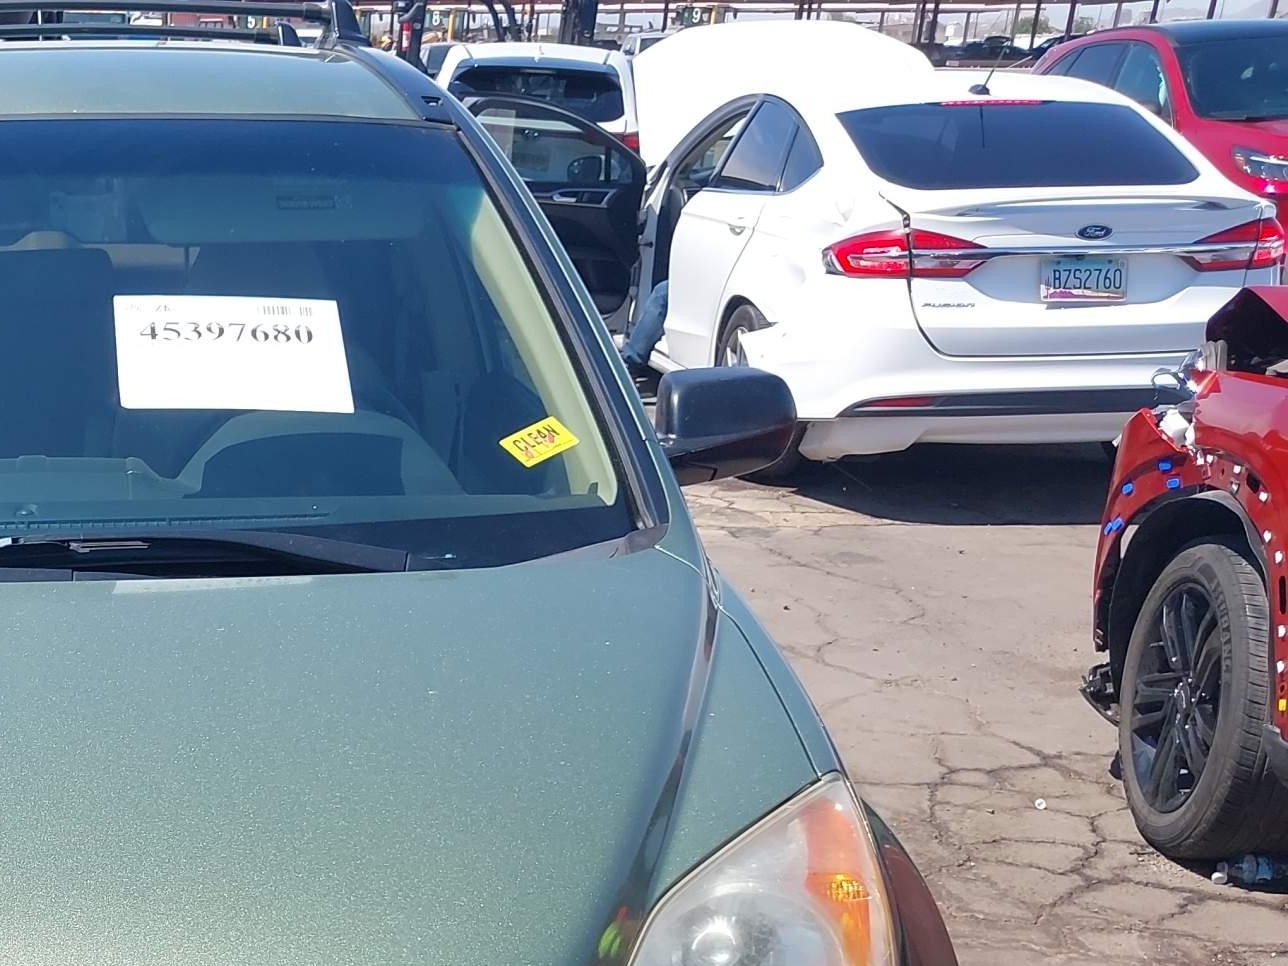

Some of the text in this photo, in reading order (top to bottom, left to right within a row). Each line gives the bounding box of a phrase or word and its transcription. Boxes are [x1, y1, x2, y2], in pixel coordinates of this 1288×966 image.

[431, 10, 441, 26] 8
[691, 7, 701, 23] 9
[1052, 267, 1123, 291] BZS2760
[139, 321, 314, 345] 45397680
[512, 424, 561, 452] CLEAN
